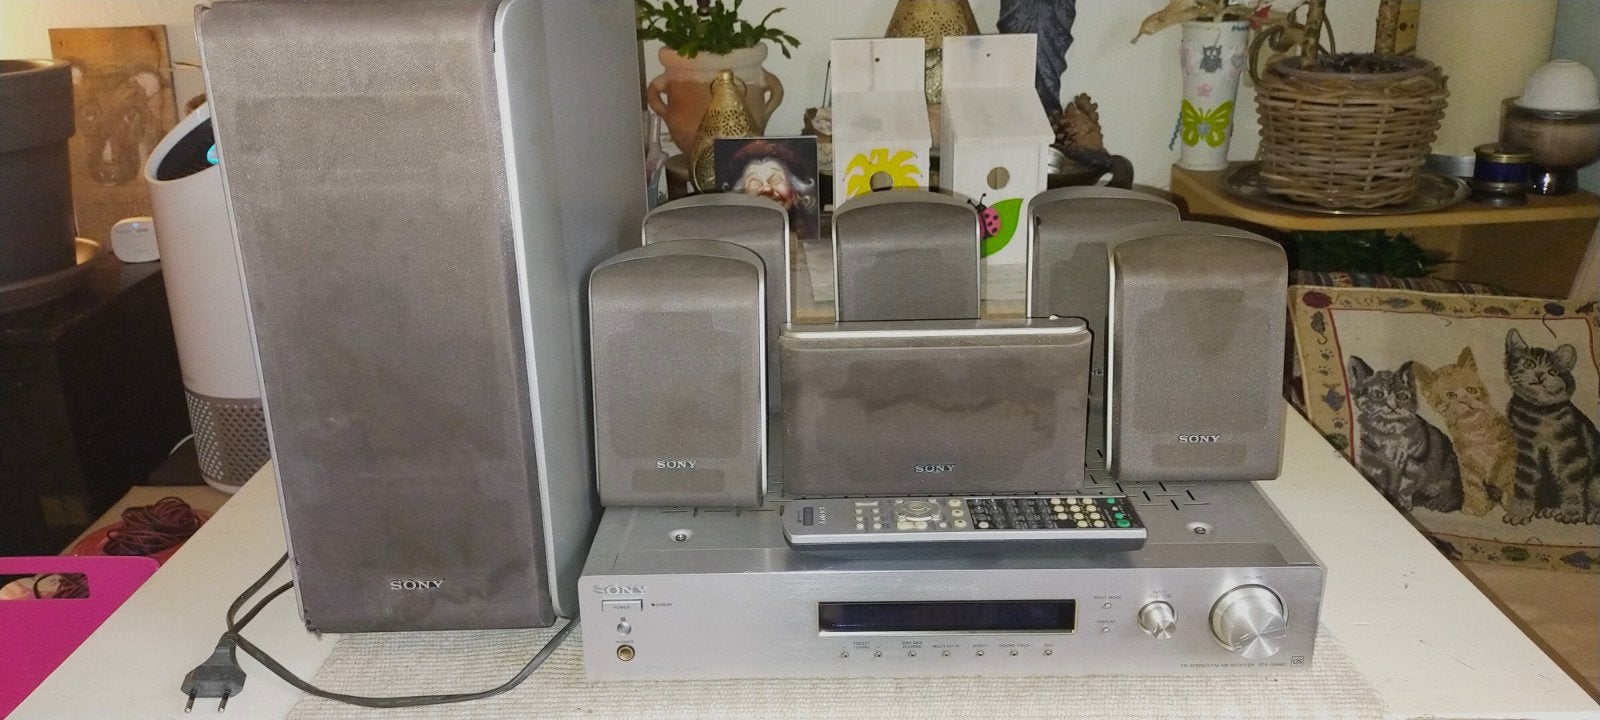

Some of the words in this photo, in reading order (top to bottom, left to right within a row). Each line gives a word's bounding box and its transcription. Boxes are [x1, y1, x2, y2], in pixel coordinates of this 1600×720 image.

[1178, 435, 1220, 443] SONY
[656, 460, 696, 469] SONY
[915, 464, 956, 473] SONY
[390, 579, 444, 591] SONY
[593, 584, 648, 595] SONY
